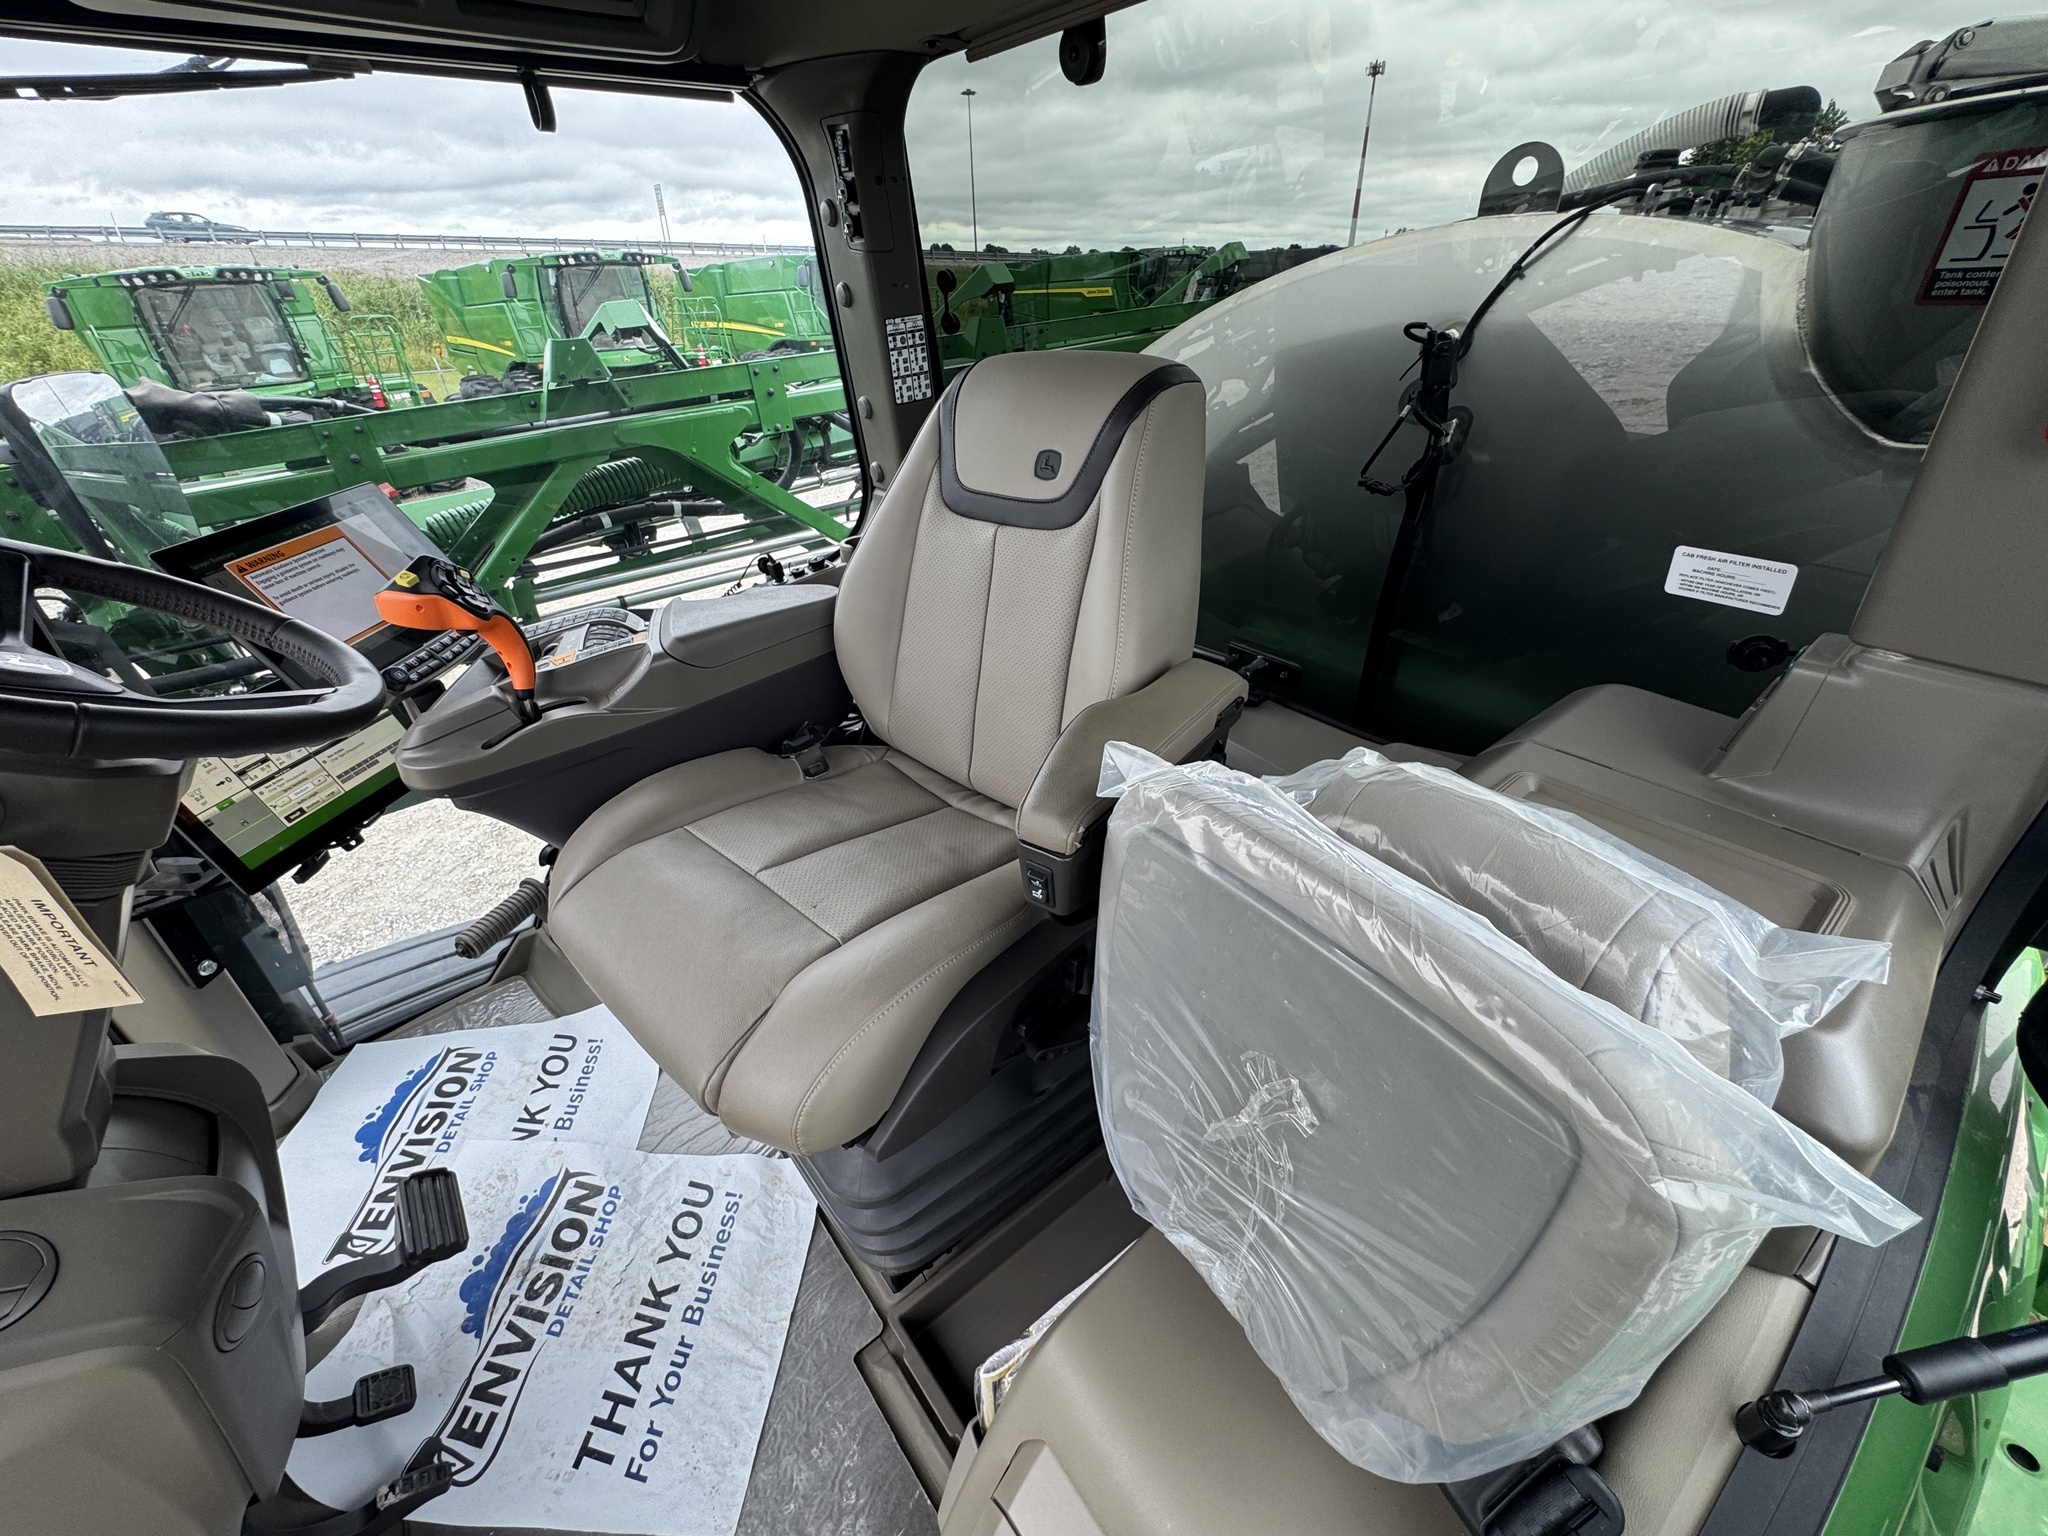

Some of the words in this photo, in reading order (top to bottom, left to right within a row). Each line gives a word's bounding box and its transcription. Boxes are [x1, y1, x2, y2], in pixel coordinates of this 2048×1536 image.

[1931, 288, 1958, 296] enter
[1960, 287, 1986, 296] tank.
[1935, 280, 1991, 289] poisonous.
[1940, 271, 1964, 279] Tank
[245, 550, 286, 569] WARNING
[250, 569, 274, 580] Automatic
[273, 561, 294, 571] Guidance
[292, 556, 308, 564] System
[256, 575, 278, 586] Engaging
[279, 566, 299, 577] guidance
[298, 560, 313, 569] system
[318, 551, 337, 560] roadways
[261, 582, 276, 591] cause
[288, 569, 307, 579] machine
[305, 563, 323, 572] control.
[1681, 551, 1696, 559] CAB
[1695, 554, 1717, 562] FRESH
[1729, 559, 1751, 568] FILTER
[1751, 564, 1788, 575] INSTALLED
[1692, 568, 1716, 577] MACHINE
[278, 595, 299, 607] guidance
[297, 589, 314, 598] system
[311, 582, 327, 591] before
[325, 575, 344, 585] entering
[279, 590, 292, 598] avoid
[290, 585, 304, 593] death
[308, 577, 324, 586] serious
[335, 565, 349, 574] disable
[3, 898, 29, 924] APPLIED
[25, 924, 44, 942] WHEN
[40, 942, 61, 962] HYDRO
[57, 962, 76, 981] LEVER
[20, 930, 39, 947] PARK
[31, 899, 98, 967] IMPORTANT
[9, 940, 24, 951] OUT
[19, 951, 31, 959] OF
[26, 960, 43, 975] PARK
[16, 936, 34, 952] PARK
[47, 974, 63, 990] MOVE
[27, 915, 48, 936] BRAKE
[50, 943, 89, 988] AUTOMATICALLY
[529, 1033, 578, 1095] YOU
[435, 1095, 477, 1153] DETAIL
[469, 1050, 498, 1092] SHOP
[553, 1038, 604, 1131] Business!
[356, 1051, 483, 1232] ENVISION
[545, 1254, 598, 1339] DETAIL
[589, 1185, 623, 1248] SHOP
[446, 1179, 606, 1449] ENVISION
[572, 1276, 681, 1471] THANK
[656, 1179, 715, 1265] YOU
[624, 1419, 664, 1484] For
[649, 1334, 695, 1409] Your
[680, 1190, 743, 1327] Business!
